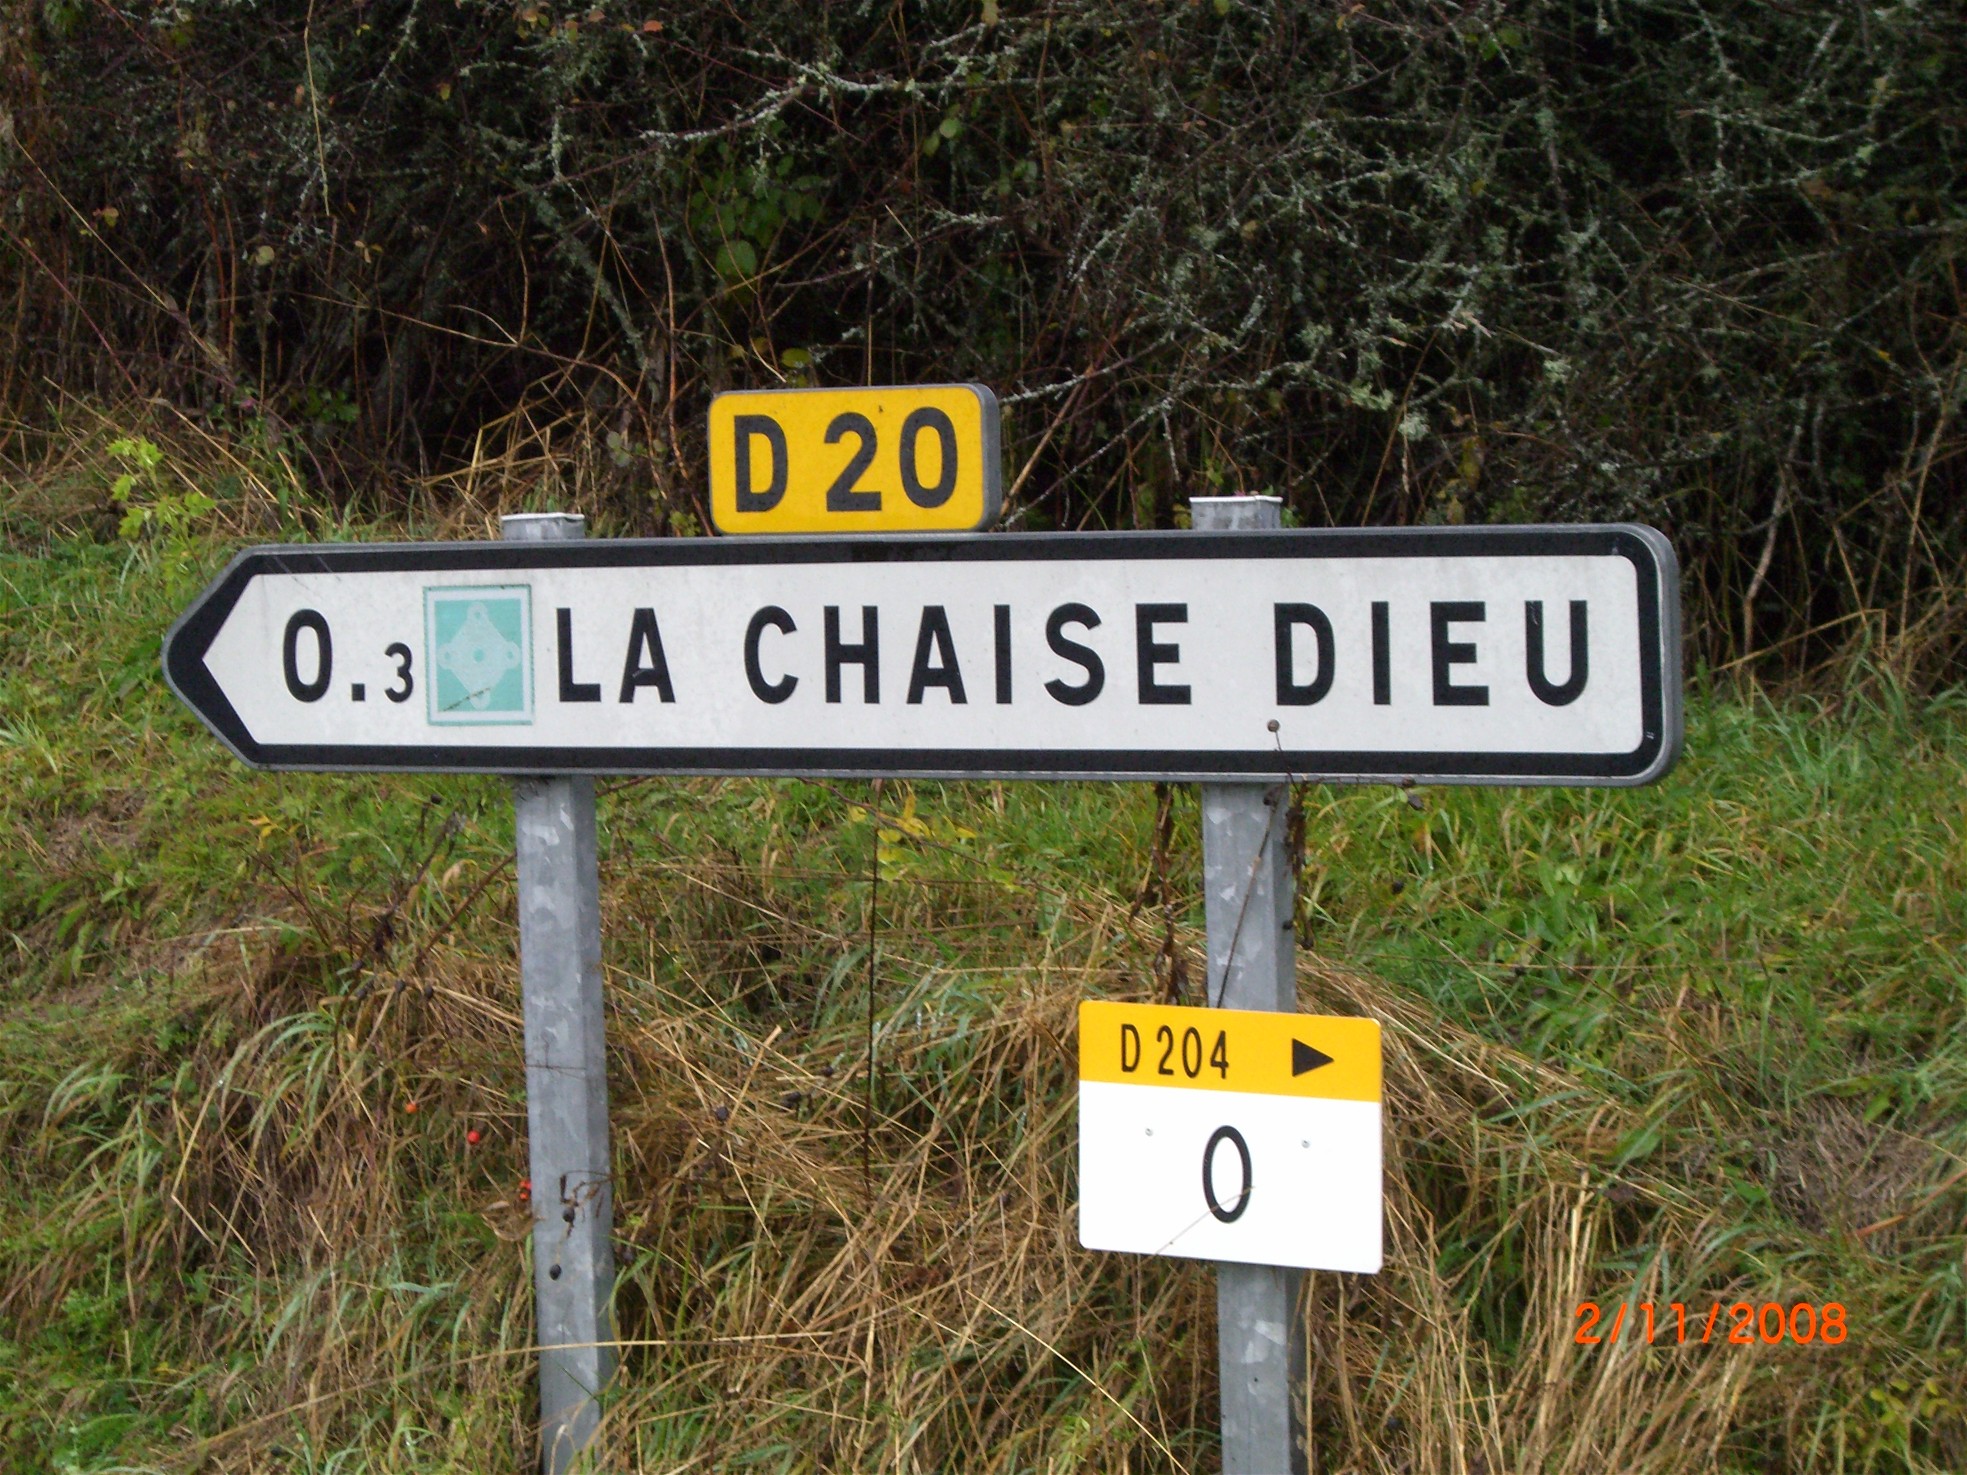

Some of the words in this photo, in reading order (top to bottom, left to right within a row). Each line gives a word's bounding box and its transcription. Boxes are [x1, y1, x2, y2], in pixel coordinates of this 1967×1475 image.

[734, 414, 788, 512] D
[824, 406, 959, 512] 20
[282, 608, 414, 703] 0.3
[556, 607, 677, 704] LA
[744, 602, 1193, 706] CHAISE
[1274, 600, 1589, 707] DIEU
[1202, 1125, 1252, 1223] 0
